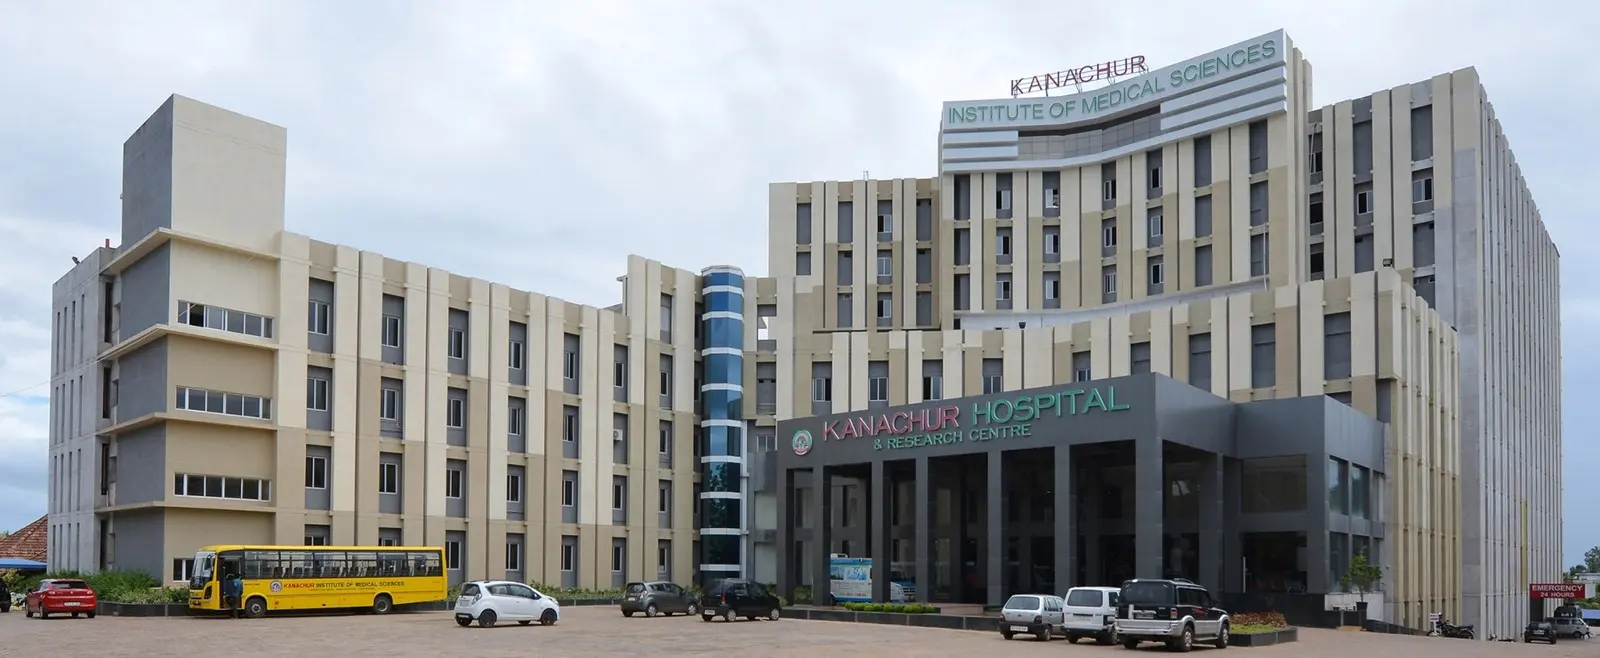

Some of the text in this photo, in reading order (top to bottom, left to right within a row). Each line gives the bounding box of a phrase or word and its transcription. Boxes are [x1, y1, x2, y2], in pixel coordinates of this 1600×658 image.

[948, 39, 1276, 124] INSTITUTE OF MEDICAL SCIENCES
[1010, 55, 1147, 96] KANACHUR
[823, 386, 1130, 441] KANACHUR HOSPITAL
[873, 423, 1032, 451] & RESEARCH CENTRE
